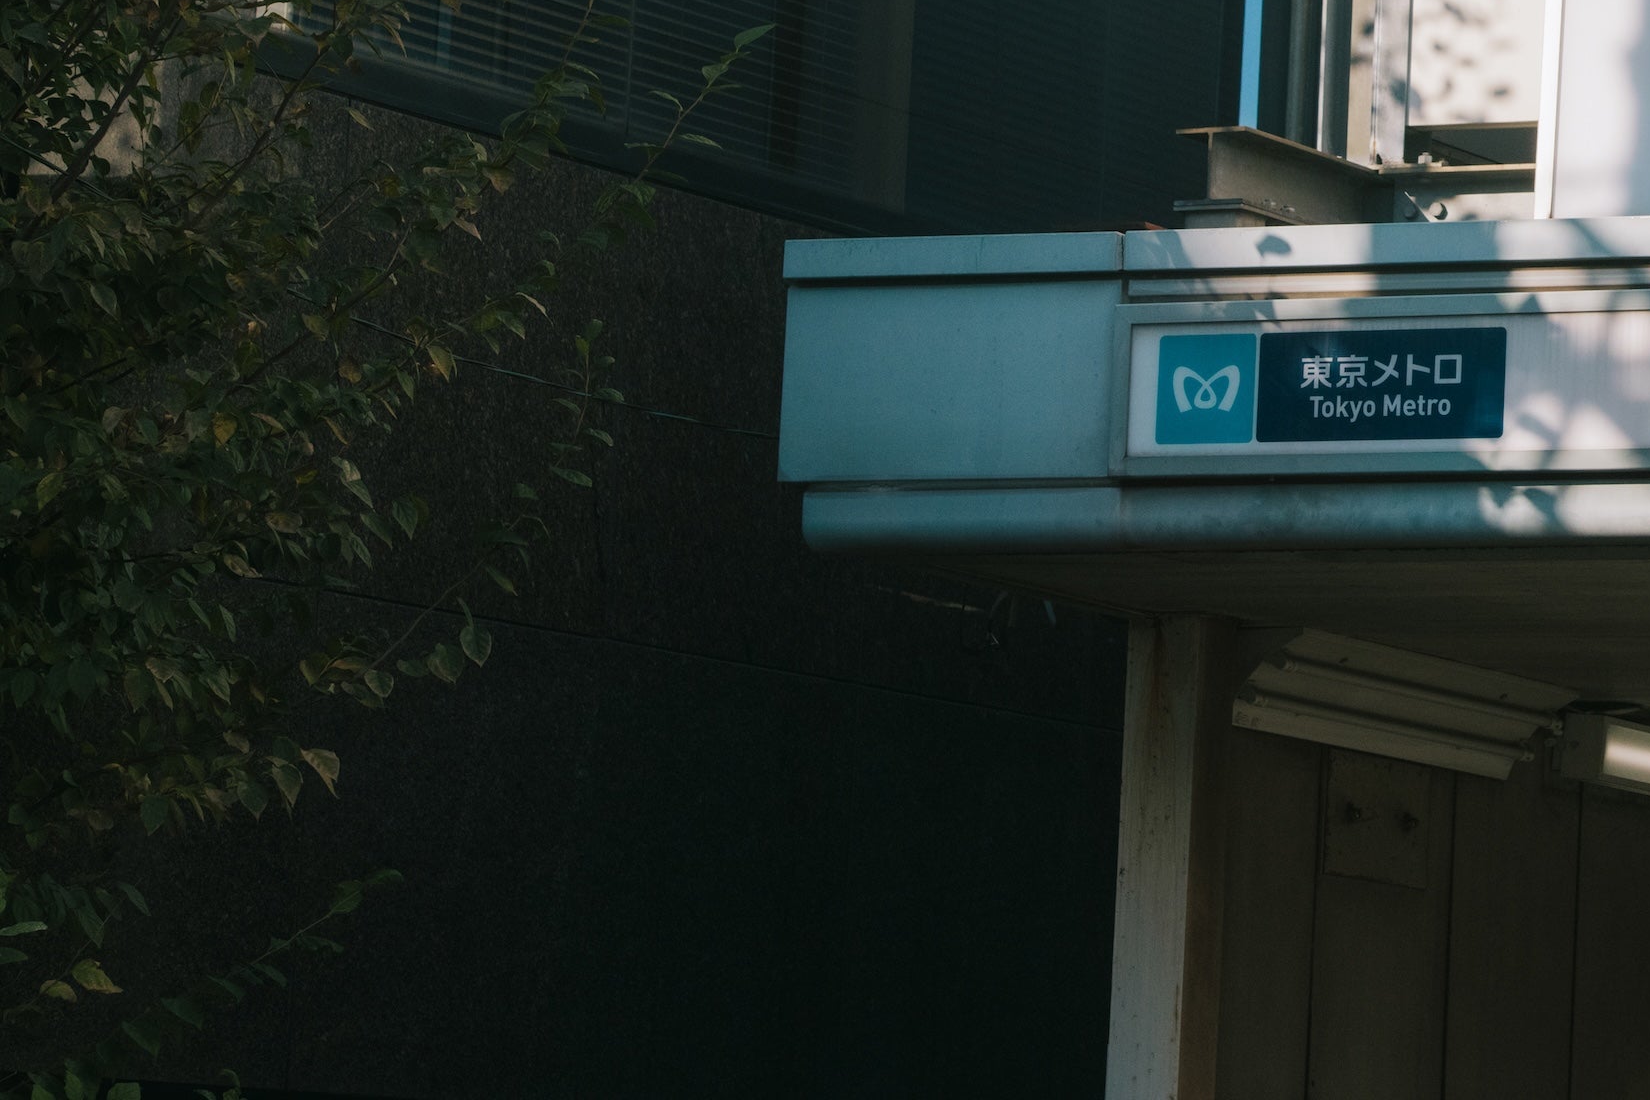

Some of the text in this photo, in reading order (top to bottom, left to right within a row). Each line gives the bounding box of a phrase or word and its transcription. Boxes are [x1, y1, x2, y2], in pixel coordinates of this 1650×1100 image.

[1300, 353, 1463, 390] 東京メトロ
[1309, 393, 1452, 422] Tokyo Metro
